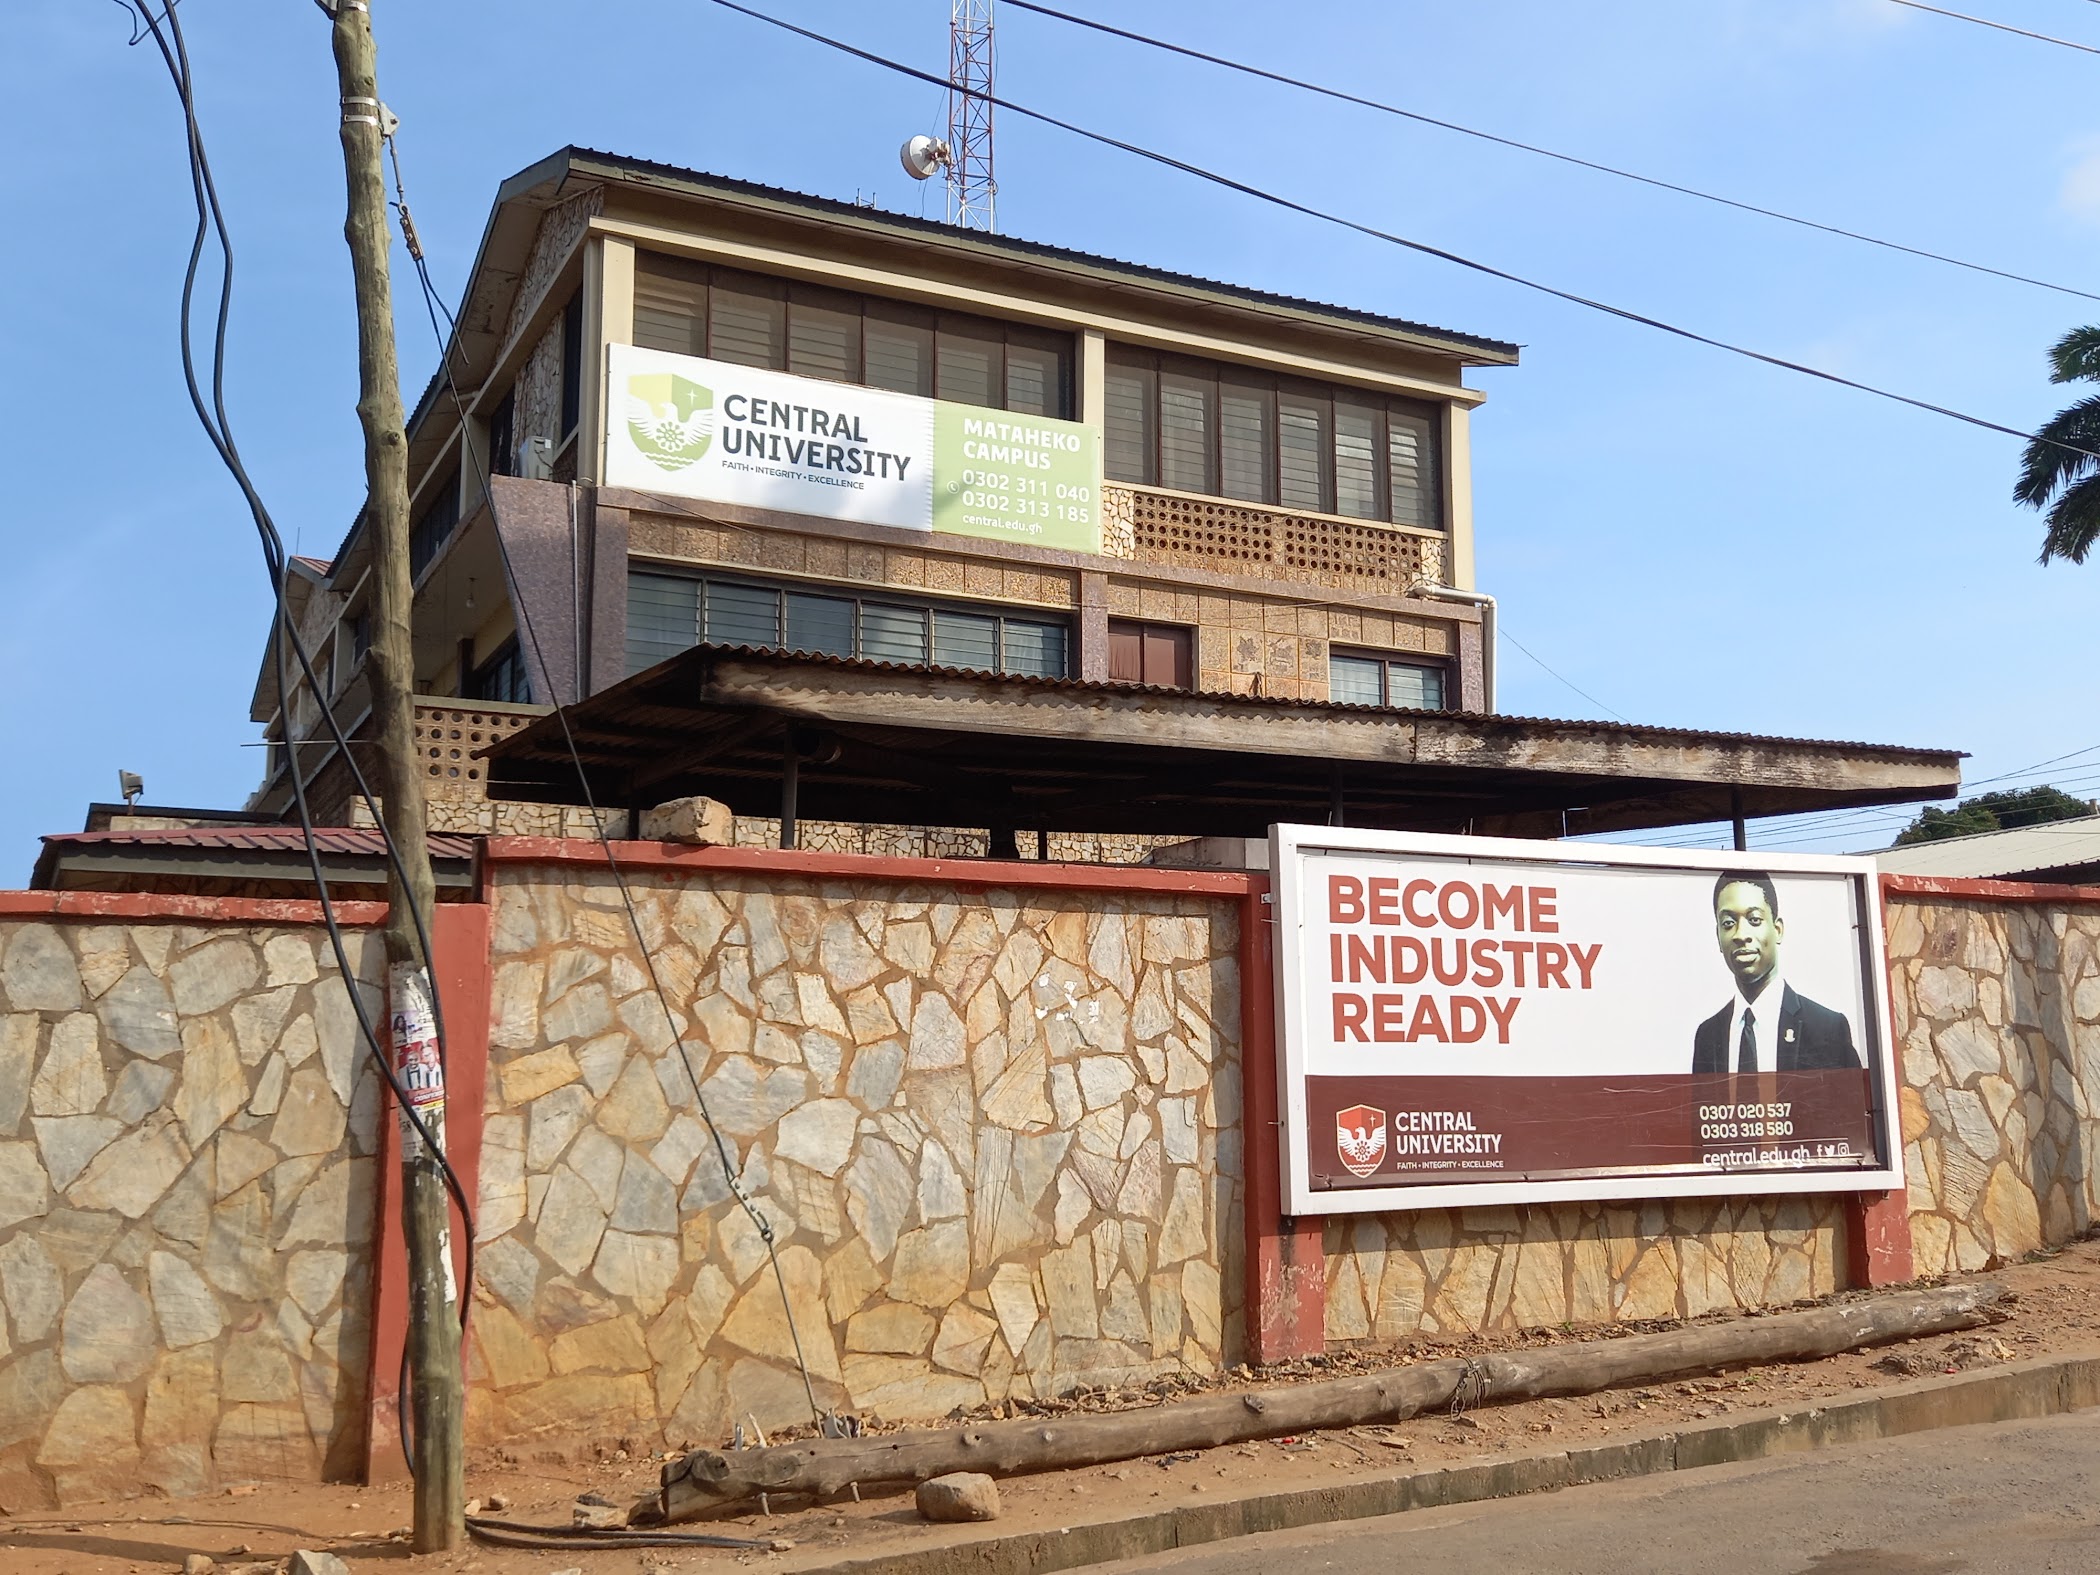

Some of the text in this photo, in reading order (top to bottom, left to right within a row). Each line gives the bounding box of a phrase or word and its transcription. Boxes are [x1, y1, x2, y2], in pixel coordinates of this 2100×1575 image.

[724, 394, 868, 443] CENTRAL
[964, 418, 1081, 452] MATAHEKO
[722, 426, 911, 481] UNIVERSITY
[963, 440, 1051, 470] CAMPUS
[721, 460, 865, 490] FAITH INTEGRITY EXCELLENCE
[962, 469, 1090, 502] 0302 311 040
[962, 490, 1089, 523] 0302 313 185
[962, 514, 1043, 535] central.edu.gh
[1328, 874, 1559, 933] BECOME
[1330, 933, 1603, 989] INDUSTRY
[1332, 992, 1522, 1044] READY
[1395, 1111, 1476, 1132] CENTRAL
[1700, 1103, 1792, 1120] 0307 020 537
[1396, 1133, 1502, 1155] UNIVERSITY
[1701, 1120, 1793, 1139] 0303 318 580
[1397, 1160, 1504, 1170] FAITH INTEGRITY EXCELLENCE
[1703, 1145, 1810, 1168] central.edu.gh
